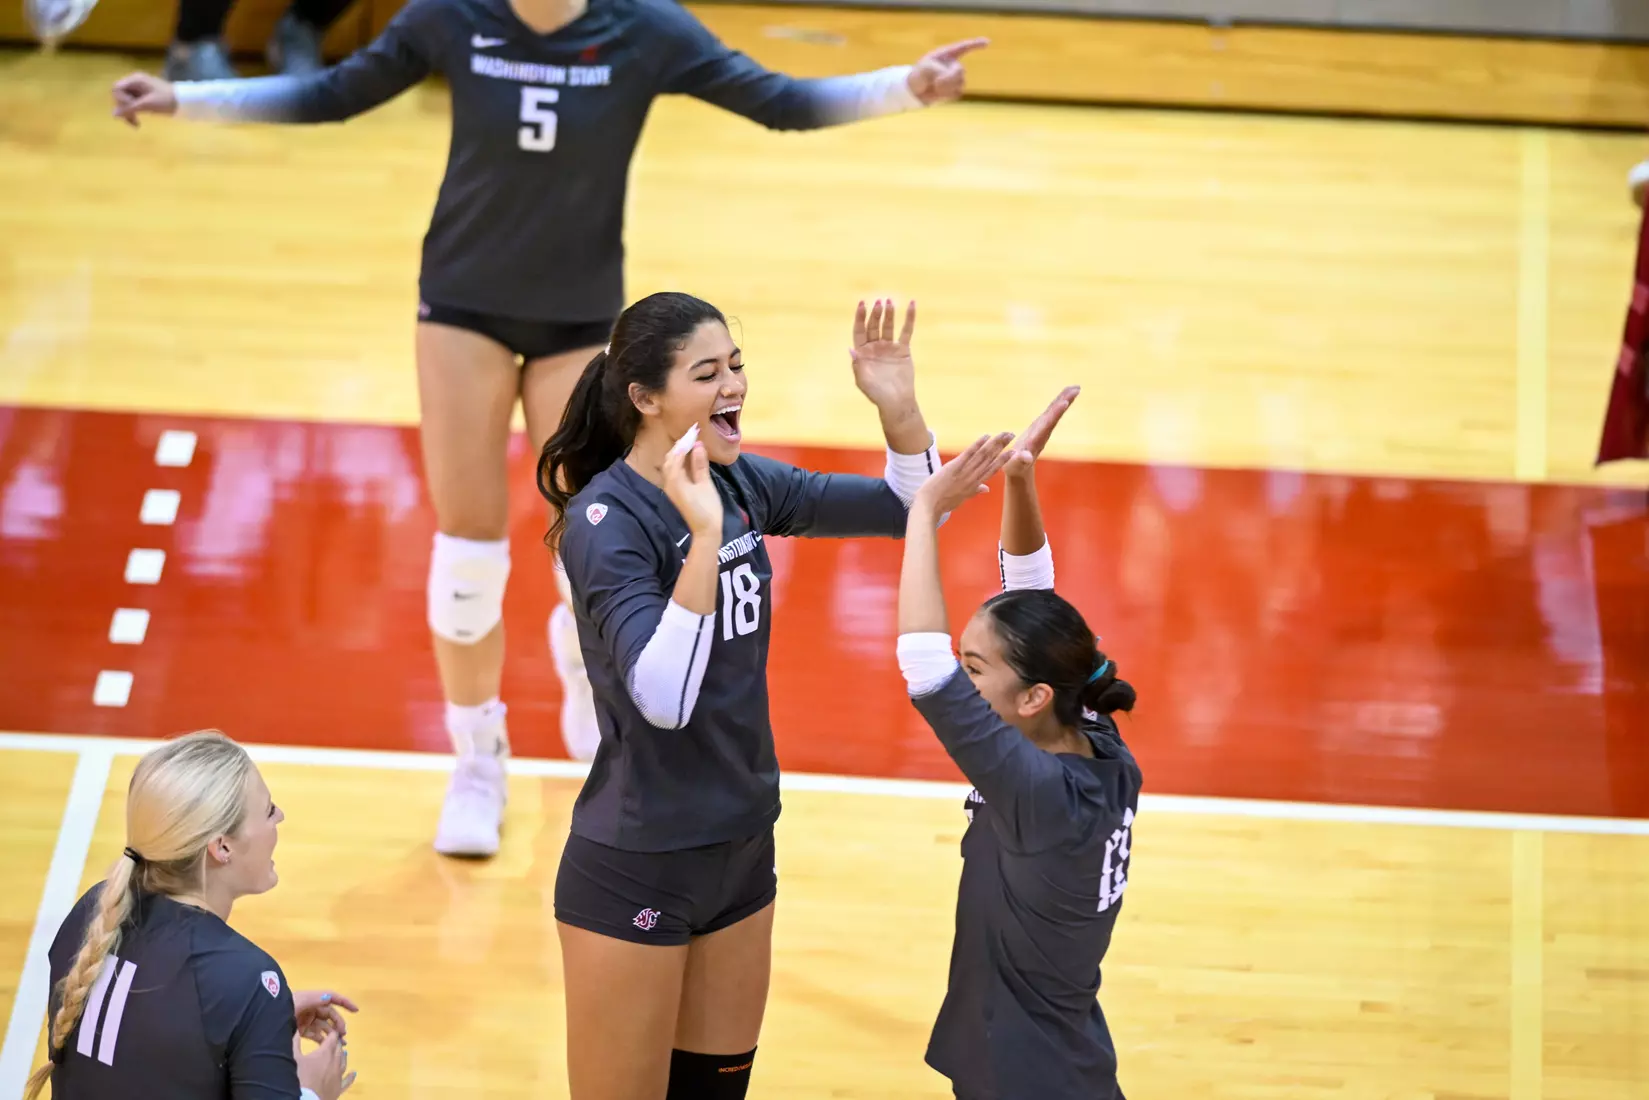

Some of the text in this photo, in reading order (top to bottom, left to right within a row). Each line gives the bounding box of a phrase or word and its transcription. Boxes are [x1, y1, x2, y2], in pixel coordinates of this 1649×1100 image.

[471, 53, 611, 86] WASHINGTON STATE
[518, 86, 559, 152] 5
[720, 563, 761, 641] 18
[77, 953, 137, 1067] 11
